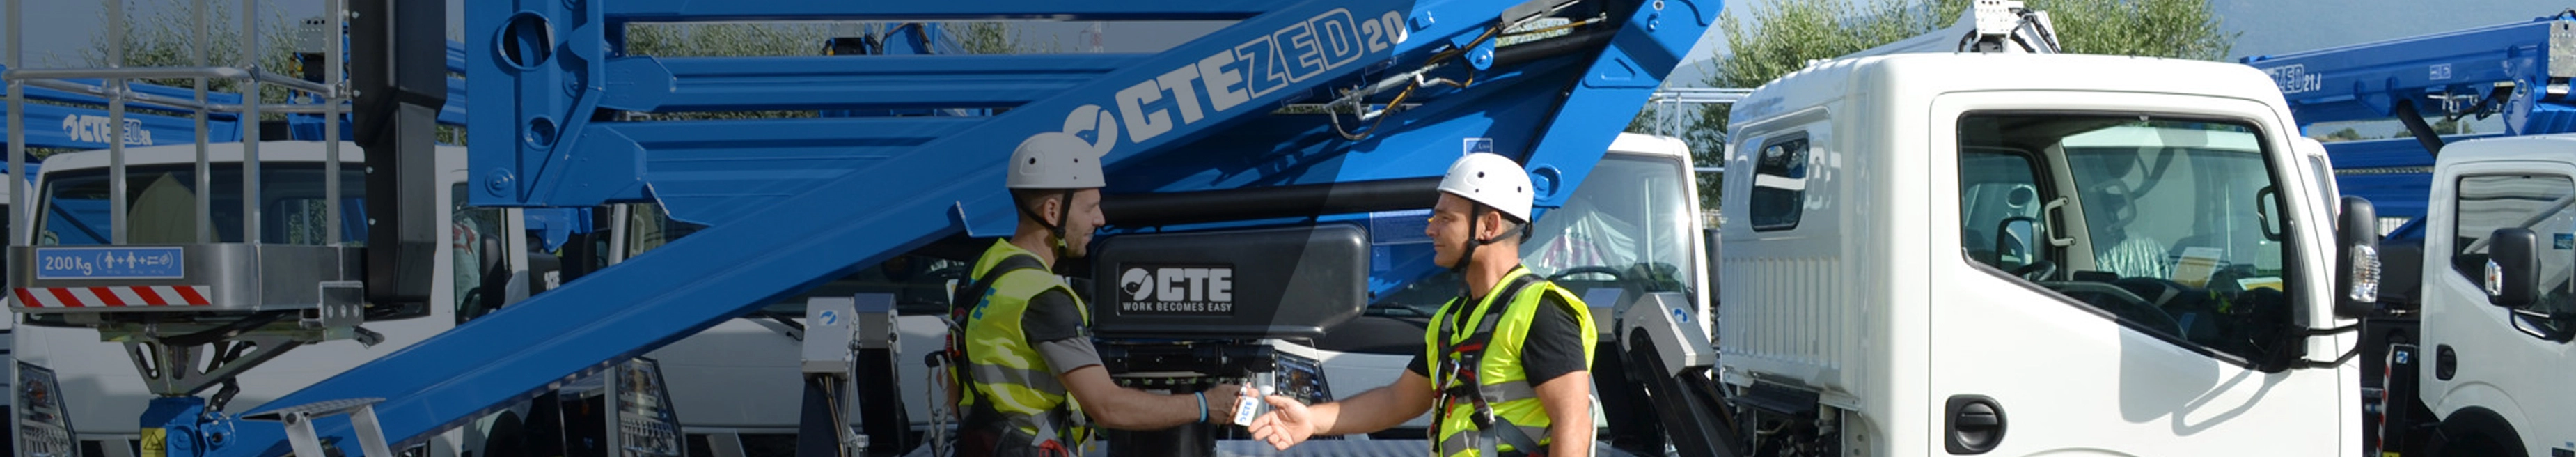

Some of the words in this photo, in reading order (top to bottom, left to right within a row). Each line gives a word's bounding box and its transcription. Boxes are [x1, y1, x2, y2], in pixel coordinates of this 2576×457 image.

[1362, 10, 1408, 54] 20
[1157, 268, 1232, 302] CTE
[1122, 302, 1153, 311] WORK
[1156, 302, 1204, 311] BECOMES
[1207, 302, 1232, 311] EASY
